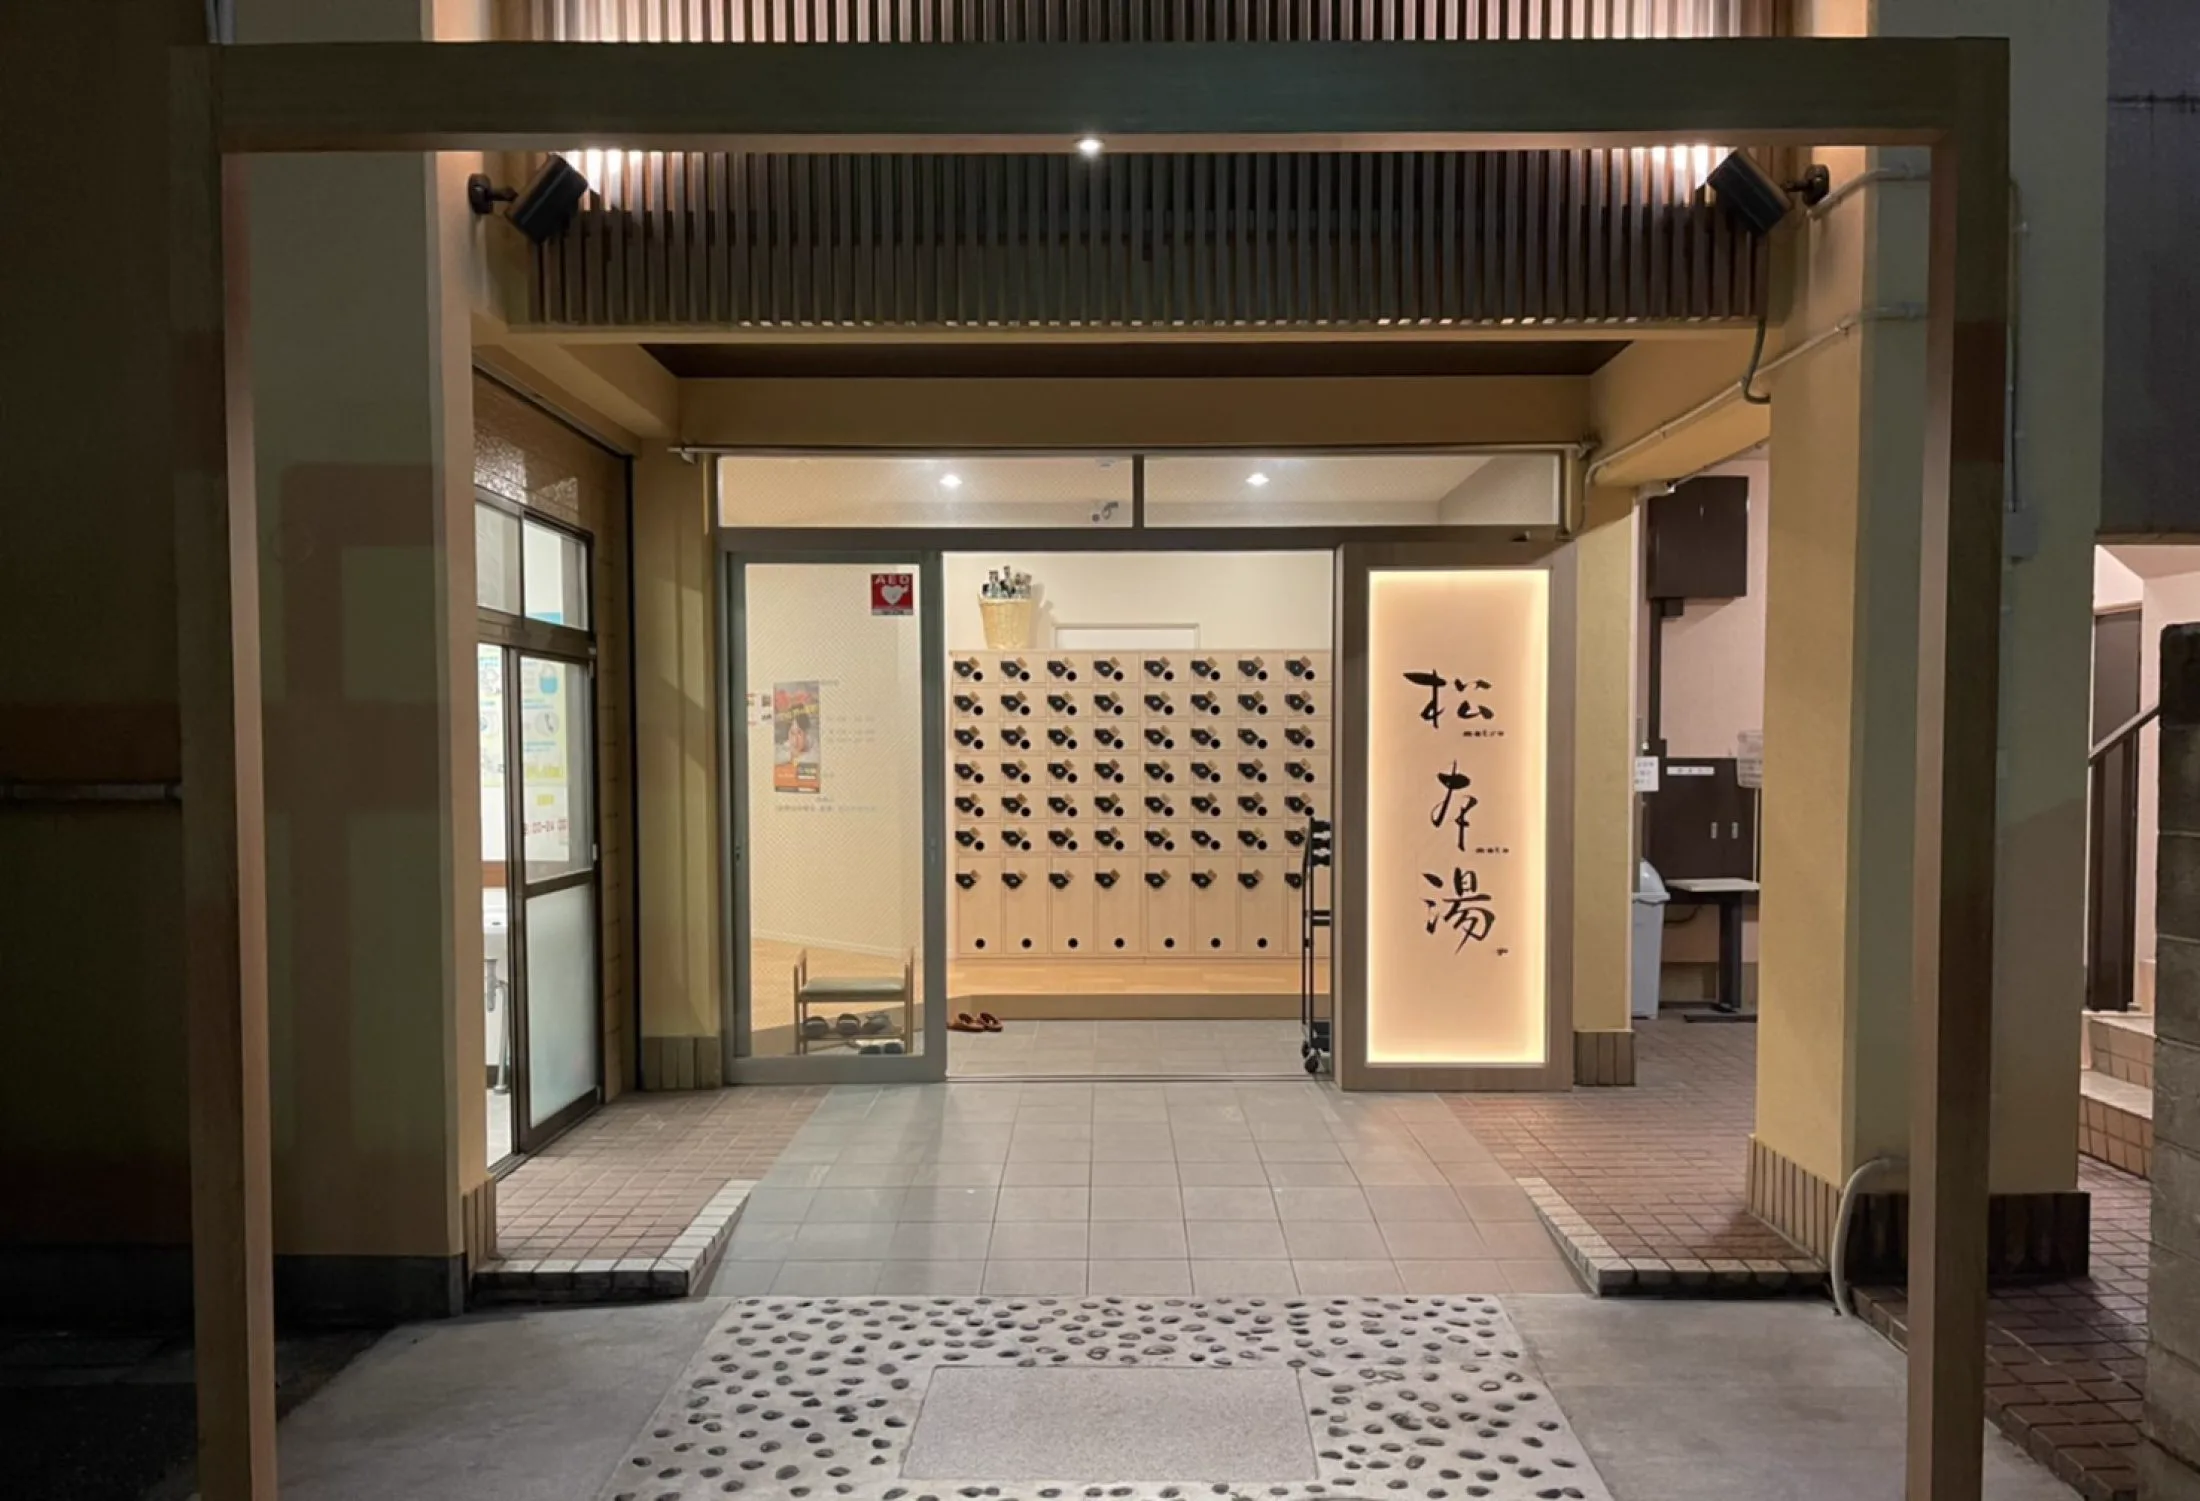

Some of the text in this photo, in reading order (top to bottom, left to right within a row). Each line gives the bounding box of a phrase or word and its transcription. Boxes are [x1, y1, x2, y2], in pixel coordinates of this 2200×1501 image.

[875, 574, 910, 585] AED
[1402, 668, 1495, 955] 松本湯
